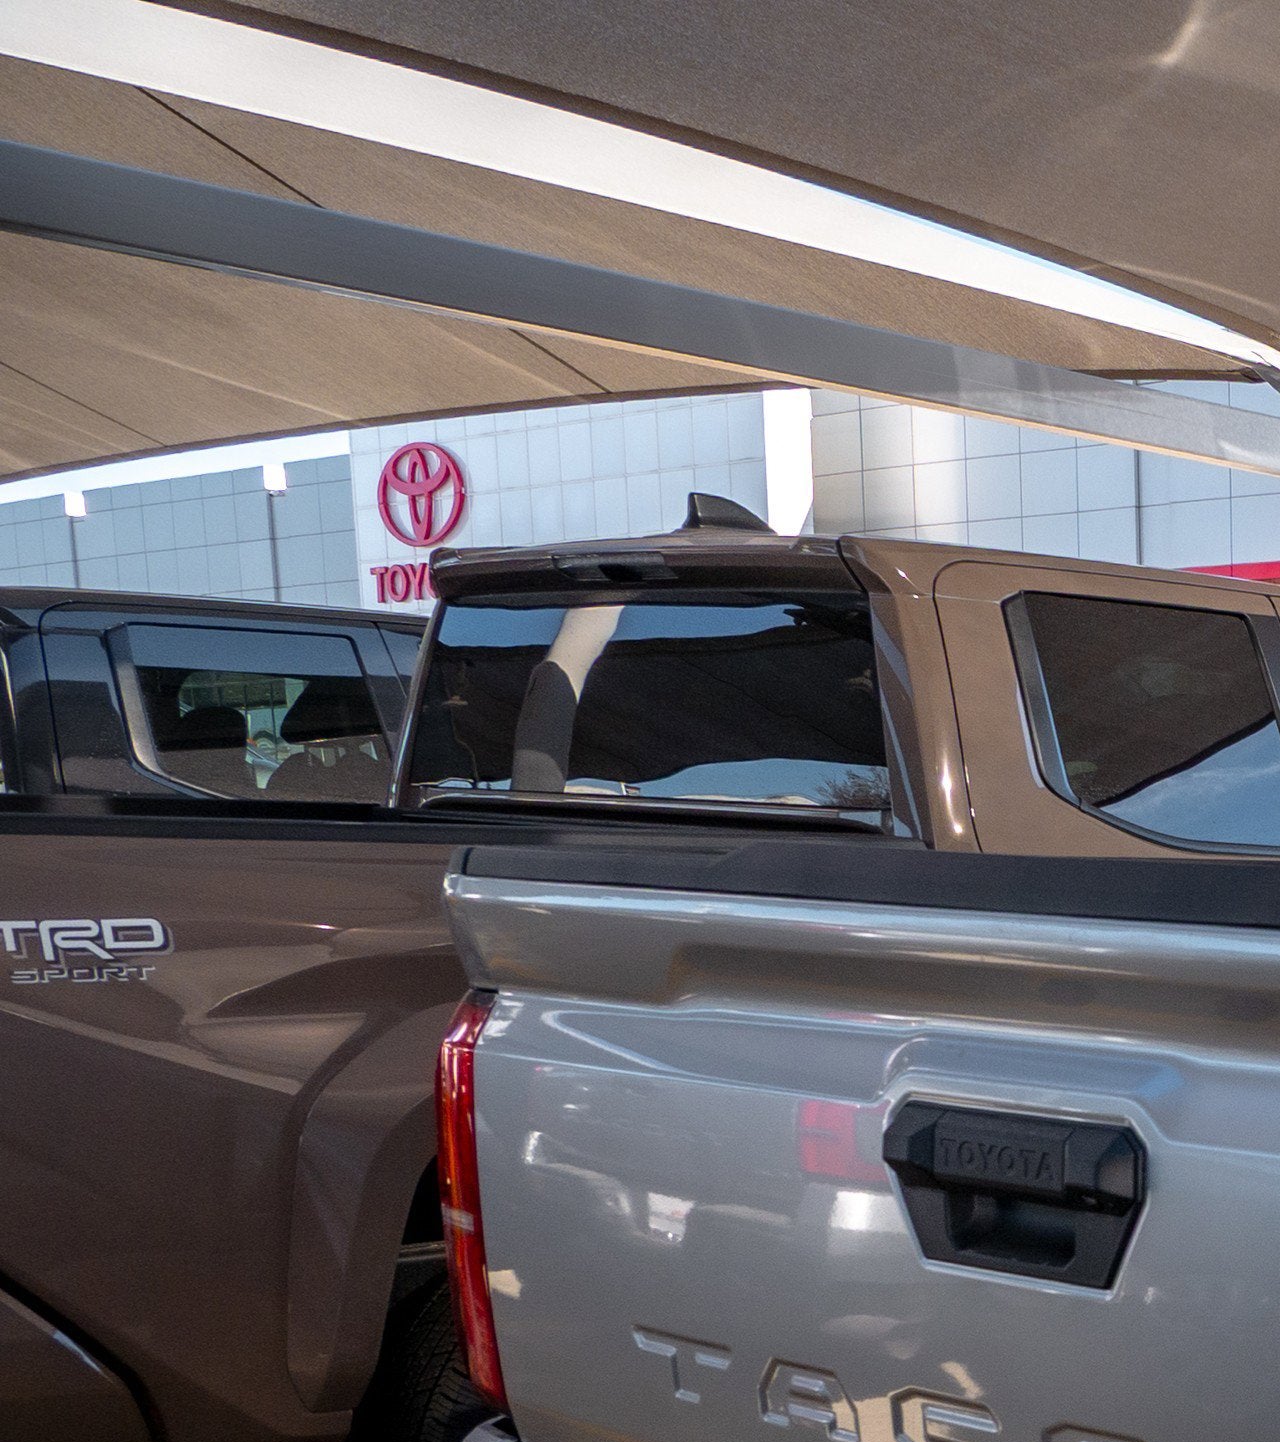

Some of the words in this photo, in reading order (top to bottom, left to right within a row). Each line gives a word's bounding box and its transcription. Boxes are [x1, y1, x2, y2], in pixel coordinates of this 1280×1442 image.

[0, 917, 168, 962] TRD
[11, 965, 157, 986] SPORT
[939, 1138, 1056, 1181] TOYOTA
